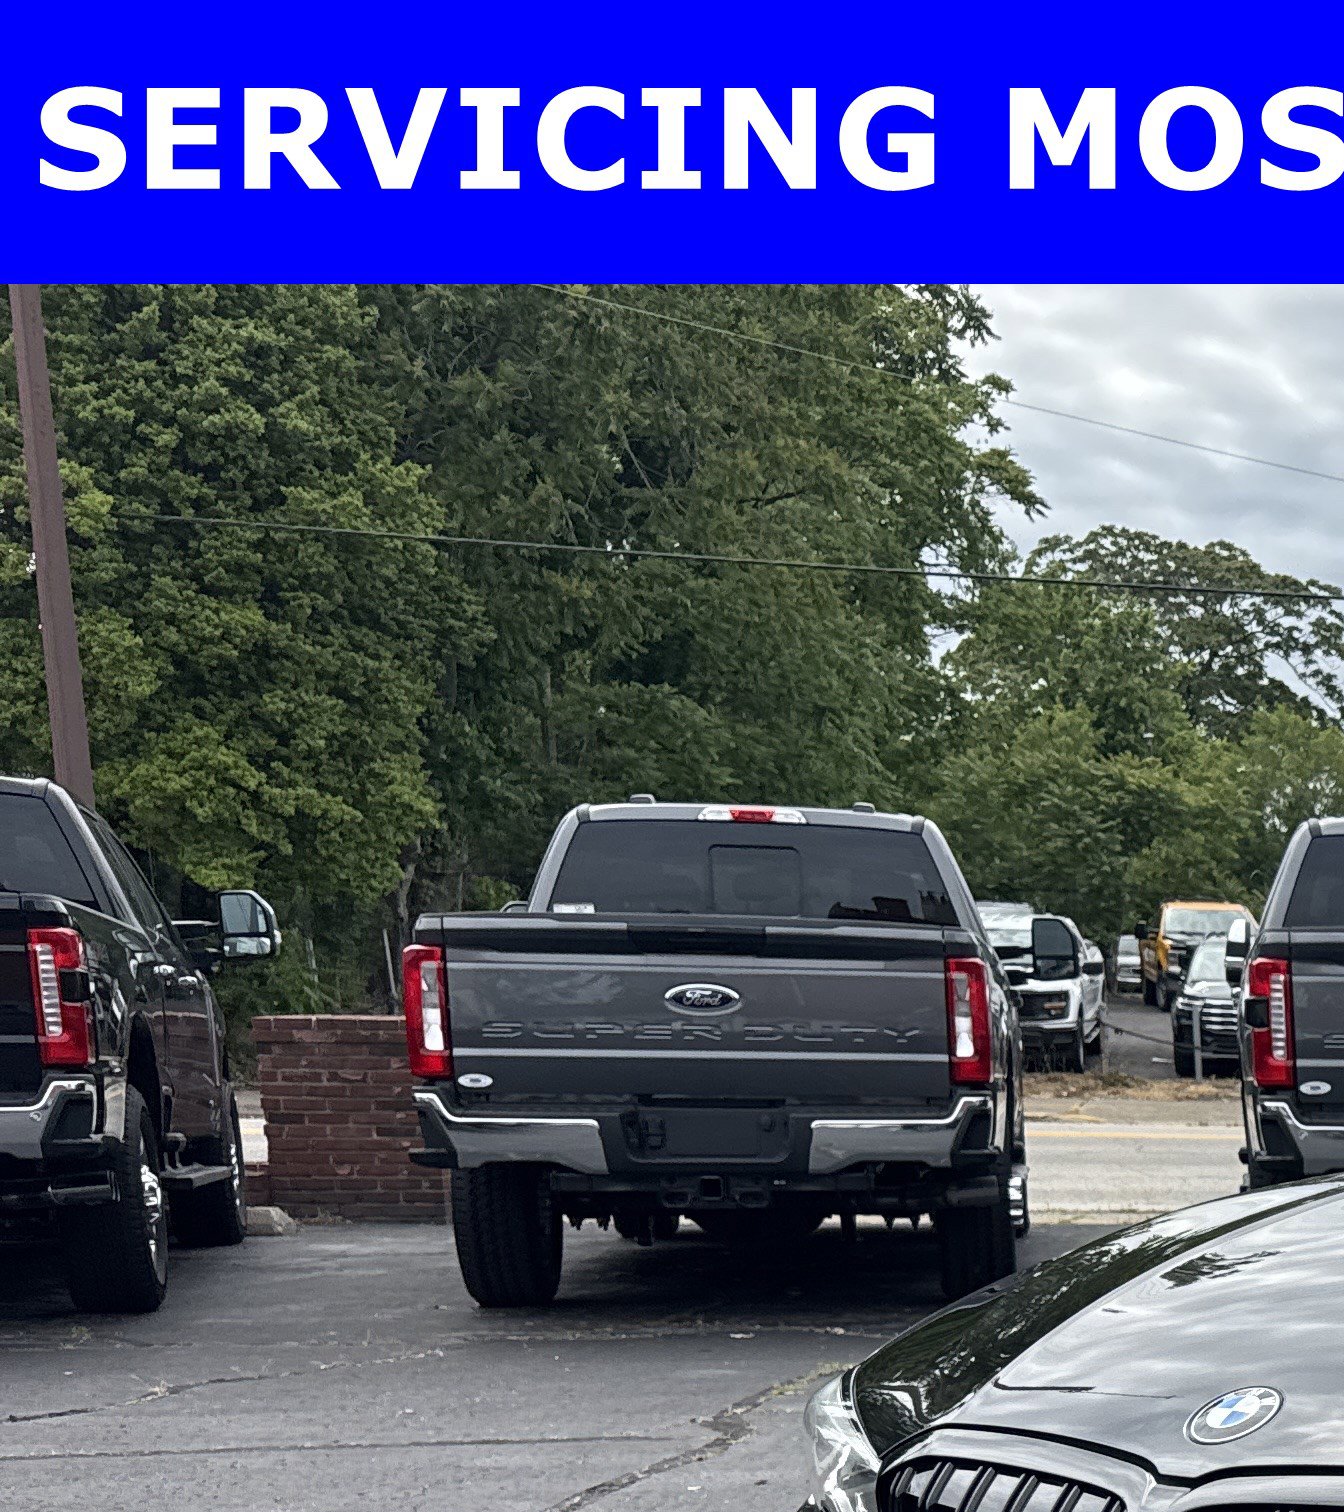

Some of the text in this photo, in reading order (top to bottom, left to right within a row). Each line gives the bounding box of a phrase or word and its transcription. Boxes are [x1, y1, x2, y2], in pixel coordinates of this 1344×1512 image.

[682, 989, 723, 1008] Ford
[481, 1020, 921, 1044] SUPER DUTY
